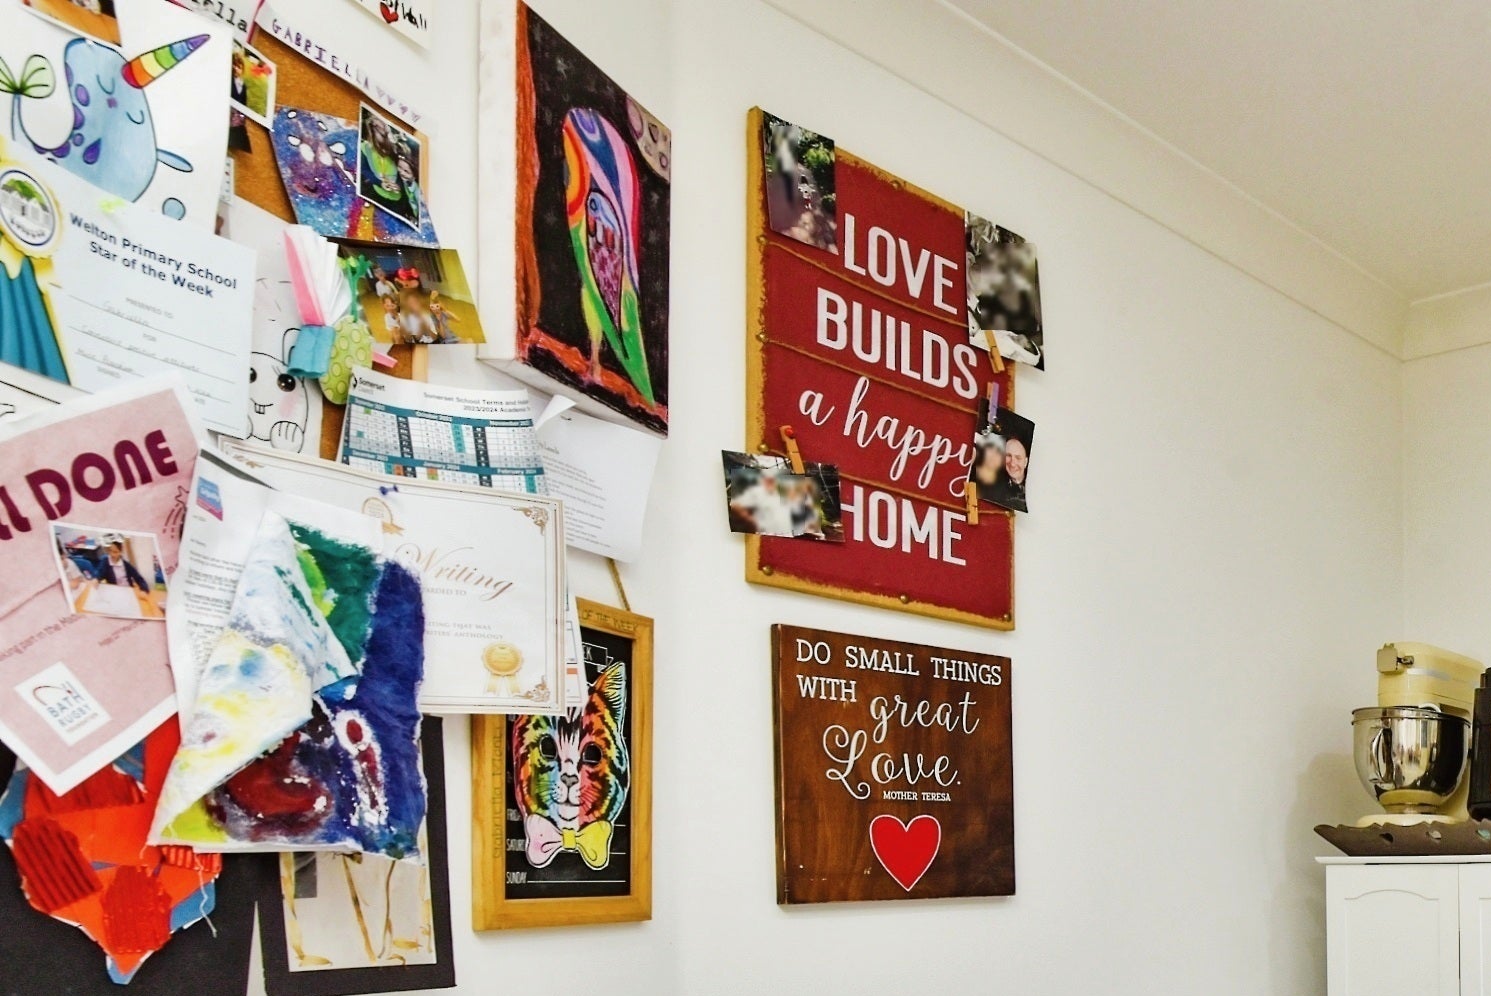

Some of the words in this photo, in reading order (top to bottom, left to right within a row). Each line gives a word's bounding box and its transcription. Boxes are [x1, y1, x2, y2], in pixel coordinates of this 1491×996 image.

[272, 18, 370, 92] GABRIELLA
[69, 213, 117, 246] Welton
[122, 239, 182, 270] Primary
[188, 262, 237, 289] School
[89, 241, 118, 261] Star
[122, 256, 137, 270] of
[141, 263, 167, 281] the
[172, 274, 214, 298] Week
[843, 212, 958, 315] LOVE
[816, 286, 978, 400] BUILDS
[359, 377, 385, 391] Somerset
[799, 388, 835, 427] a
[843, 376, 975, 498] happy
[25, 429, 178, 520] DONE
[840, 484, 967, 566] HOME
[395, 543, 513, 601] Writing
[796, 638, 831, 665] DO
[845, 645, 920, 676] SMALL
[930, 657, 1002, 686] THINGS
[46, 681, 85, 718] BATH
[796, 675, 857, 702] WITH
[869, 691, 980, 743] great
[822, 725, 961, 800] Love.
[883, 790, 918, 801] MOTHER
[921, 792, 951, 802] TERESA
[506, 871, 528, 884] SUNDAY
